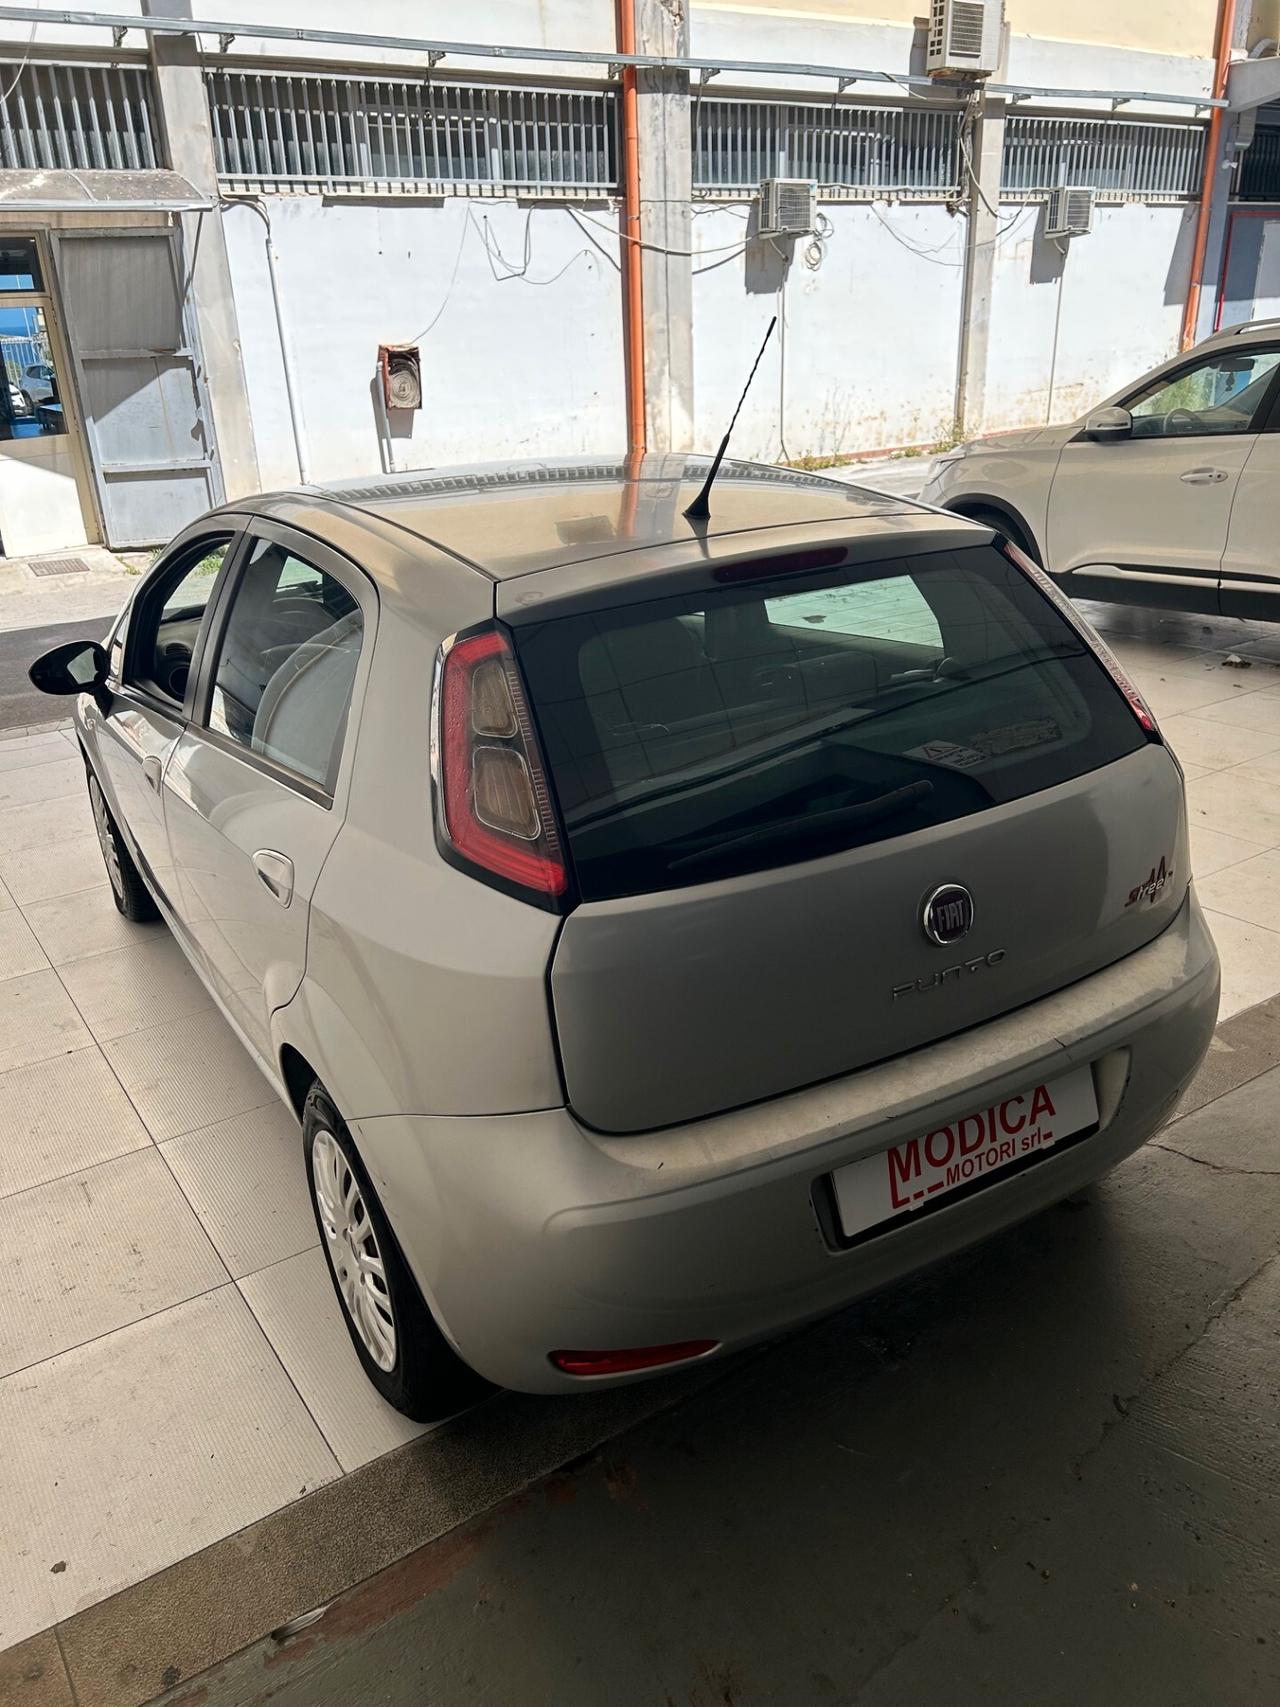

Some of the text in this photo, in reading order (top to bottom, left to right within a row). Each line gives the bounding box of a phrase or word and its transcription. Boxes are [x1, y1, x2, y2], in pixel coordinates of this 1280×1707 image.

[936, 899, 965, 934] FIAT
[892, 948, 1006, 1000] PUNTO
[887, 1084, 1056, 1192] MODICA
[946, 1127, 1041, 1187] MOTORI srl
